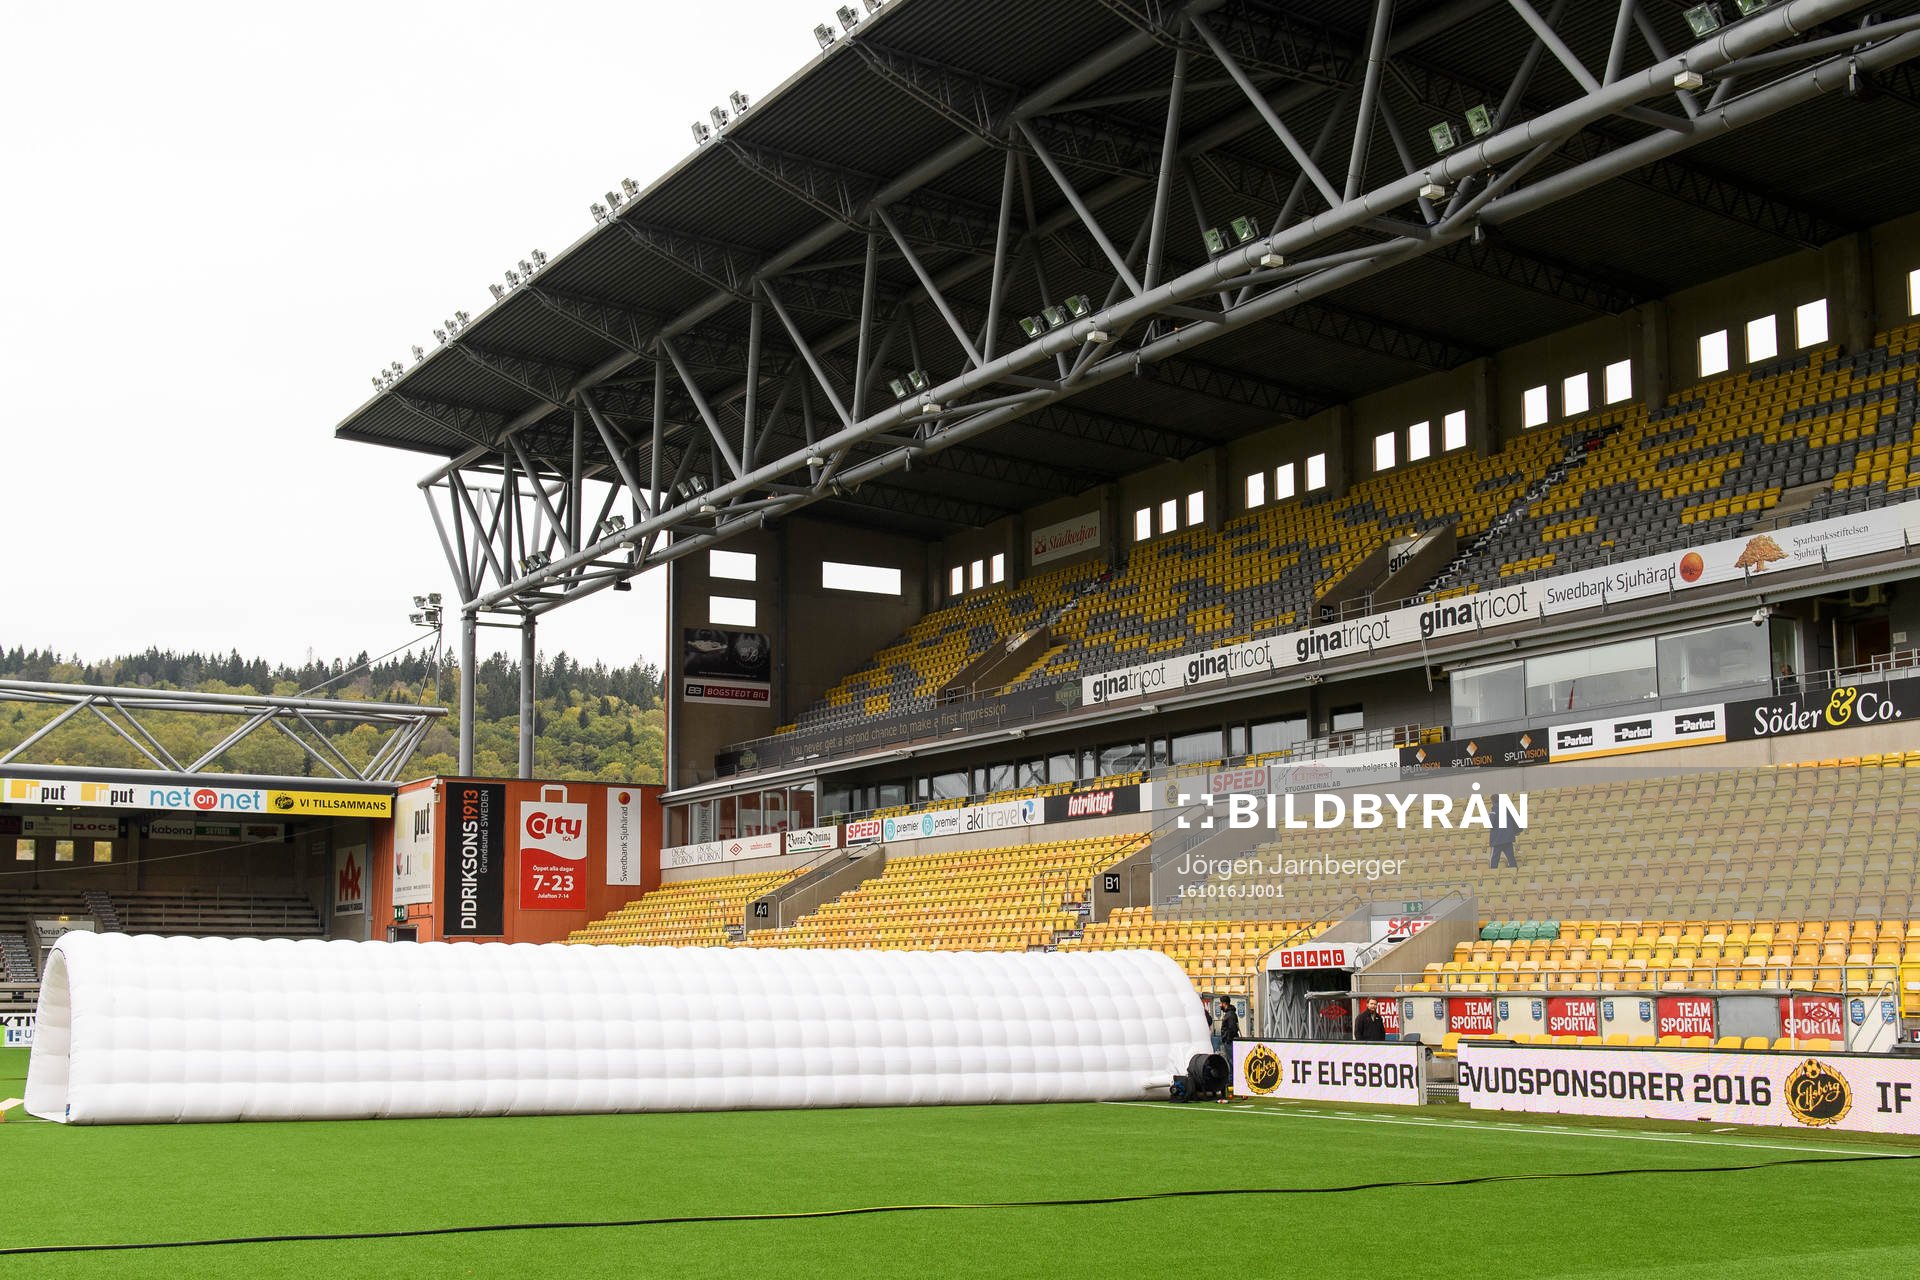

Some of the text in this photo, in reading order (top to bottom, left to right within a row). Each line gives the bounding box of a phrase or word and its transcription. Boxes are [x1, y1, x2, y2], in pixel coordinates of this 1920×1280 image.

[1793, 525, 1869, 547] Sparbanksstiftelsen
[1547, 562, 1676, 604] Swedbank Sjuhärad
[707, 688, 766, 699] BOGSTEDT BIL
[1754, 687, 1902, 736] Söder & Co.
[804, 741, 824, 753] never
[844, 731, 870, 745] second
[871, 723, 898, 741] chance
[900, 723, 908, 735] to
[909, 717, 931, 733] make
[941, 712, 958, 726] first
[960, 703, 1006, 724] impression
[1683, 718, 1715, 732] Parker
[1621, 726, 1652, 739] Parker
[1564, 734, 1593, 747] Parker
[1451, 755, 1493, 768] SPLITVISION
[1504, 748, 1548, 762] SPLITVISION
[1346, 761, 1398, 774] www.holgers.se
[1401, 761, 1441, 775] SPLITVISION
[1212, 769, 1266, 793] SPEED
[1285, 780, 1341, 793] STUGMATERIAL AB
[300, 799, 310, 808] VI
[312, 799, 387, 810] TILLSAMMANS
[1068, 791, 1114, 817] fotriktigt
[935, 816, 959, 829] premier
[966, 802, 1020, 831] aki travel
[152, 825, 193, 835] kabona
[480, 789, 489, 874] Grundsund SWEDEN
[526, 811, 582, 840] City
[847, 821, 881, 839] SPEED
[896, 822, 919, 835] premier
[620, 842, 628, 882] Swedbank
[532, 874, 575, 891] 7-23
[1105, 877, 1120, 890] B1
[756, 904, 768, 915] A1
[1282, 952, 1344, 965] CRAMO
[1464, 1002, 1492, 1015] TEAM
[1565, 1002, 1595, 1017] TEAM
[1677, 1002, 1711, 1017] TEAM
[1451, 1016, 1493, 1030] SPORTIA
[1550, 1017, 1596, 1031] SPORTIA
[1661, 1018, 1712, 1033] SPORTIA
[1291, 1059, 1419, 1089] IF ELFSBOR
[1693, 1073, 1772, 1107] 2016
[1876, 1082, 1912, 1114] IF
